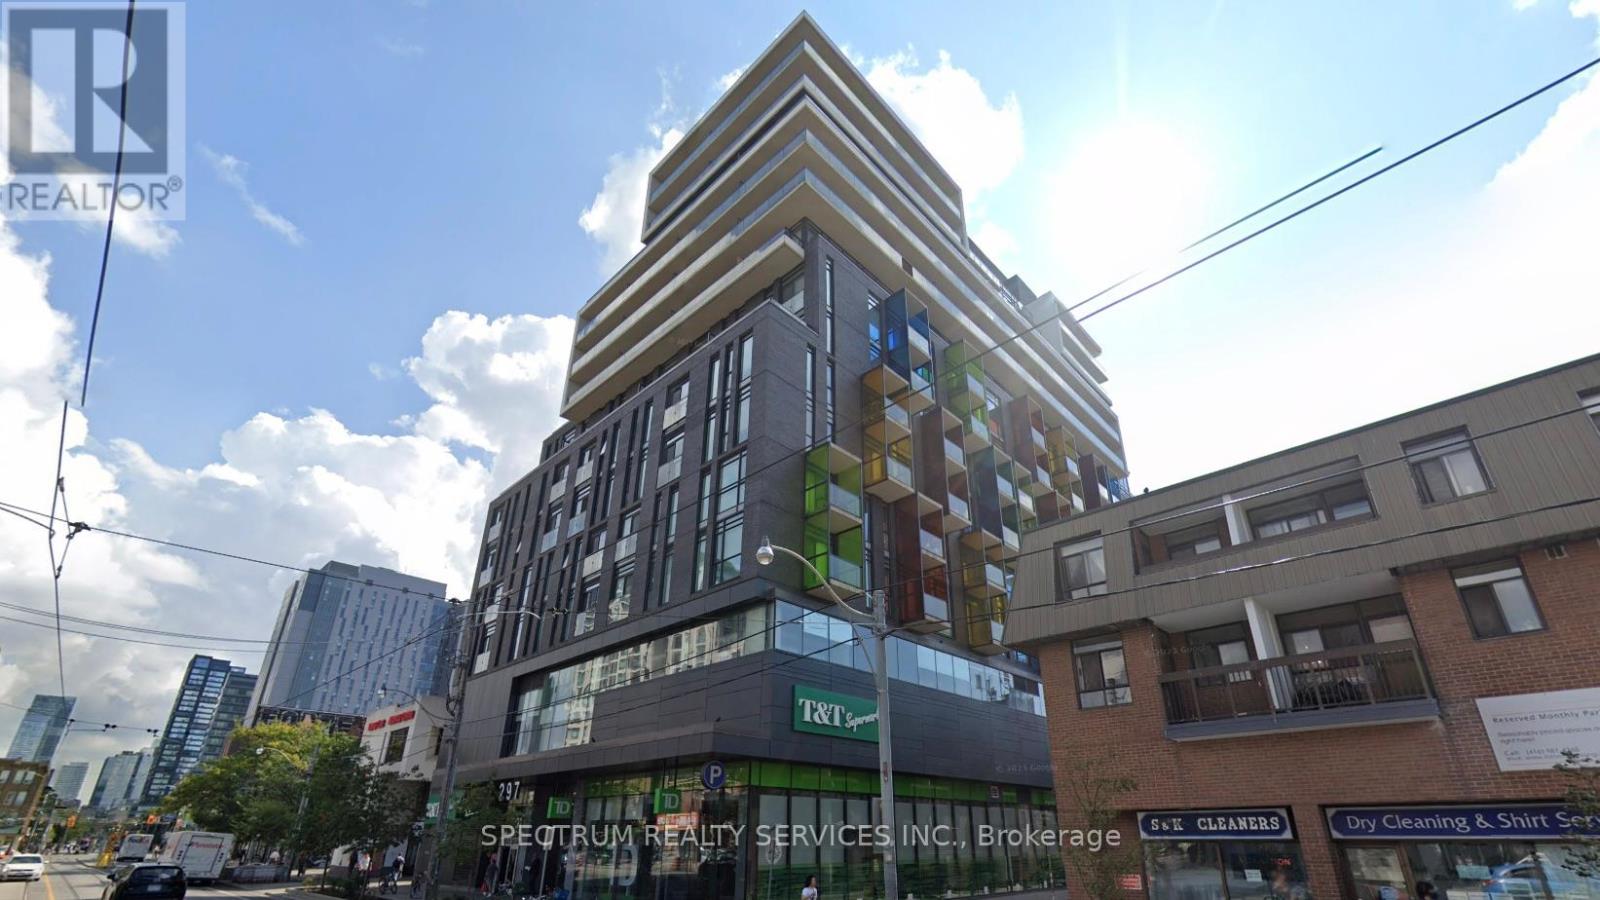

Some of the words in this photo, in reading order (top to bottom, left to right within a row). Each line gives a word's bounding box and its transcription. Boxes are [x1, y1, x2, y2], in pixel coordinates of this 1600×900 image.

[798, 698, 845, 728] T&T
[845, 705, 880, 732] Supermar
[1538, 710, 1580, 720] Monthly
[709, 765, 722, 784] P
[499, 781, 520, 801] 297
[555, 801, 571, 815] TD
[662, 793, 679, 809] TD
[1197, 816, 1280, 830] CLEANERS
[1346, 815, 1376, 833] Dry
[1382, 814, 1471, 833] Cleaning
[1475, 813, 1494, 829] &
[1497, 812, 1550, 829] Shirt
